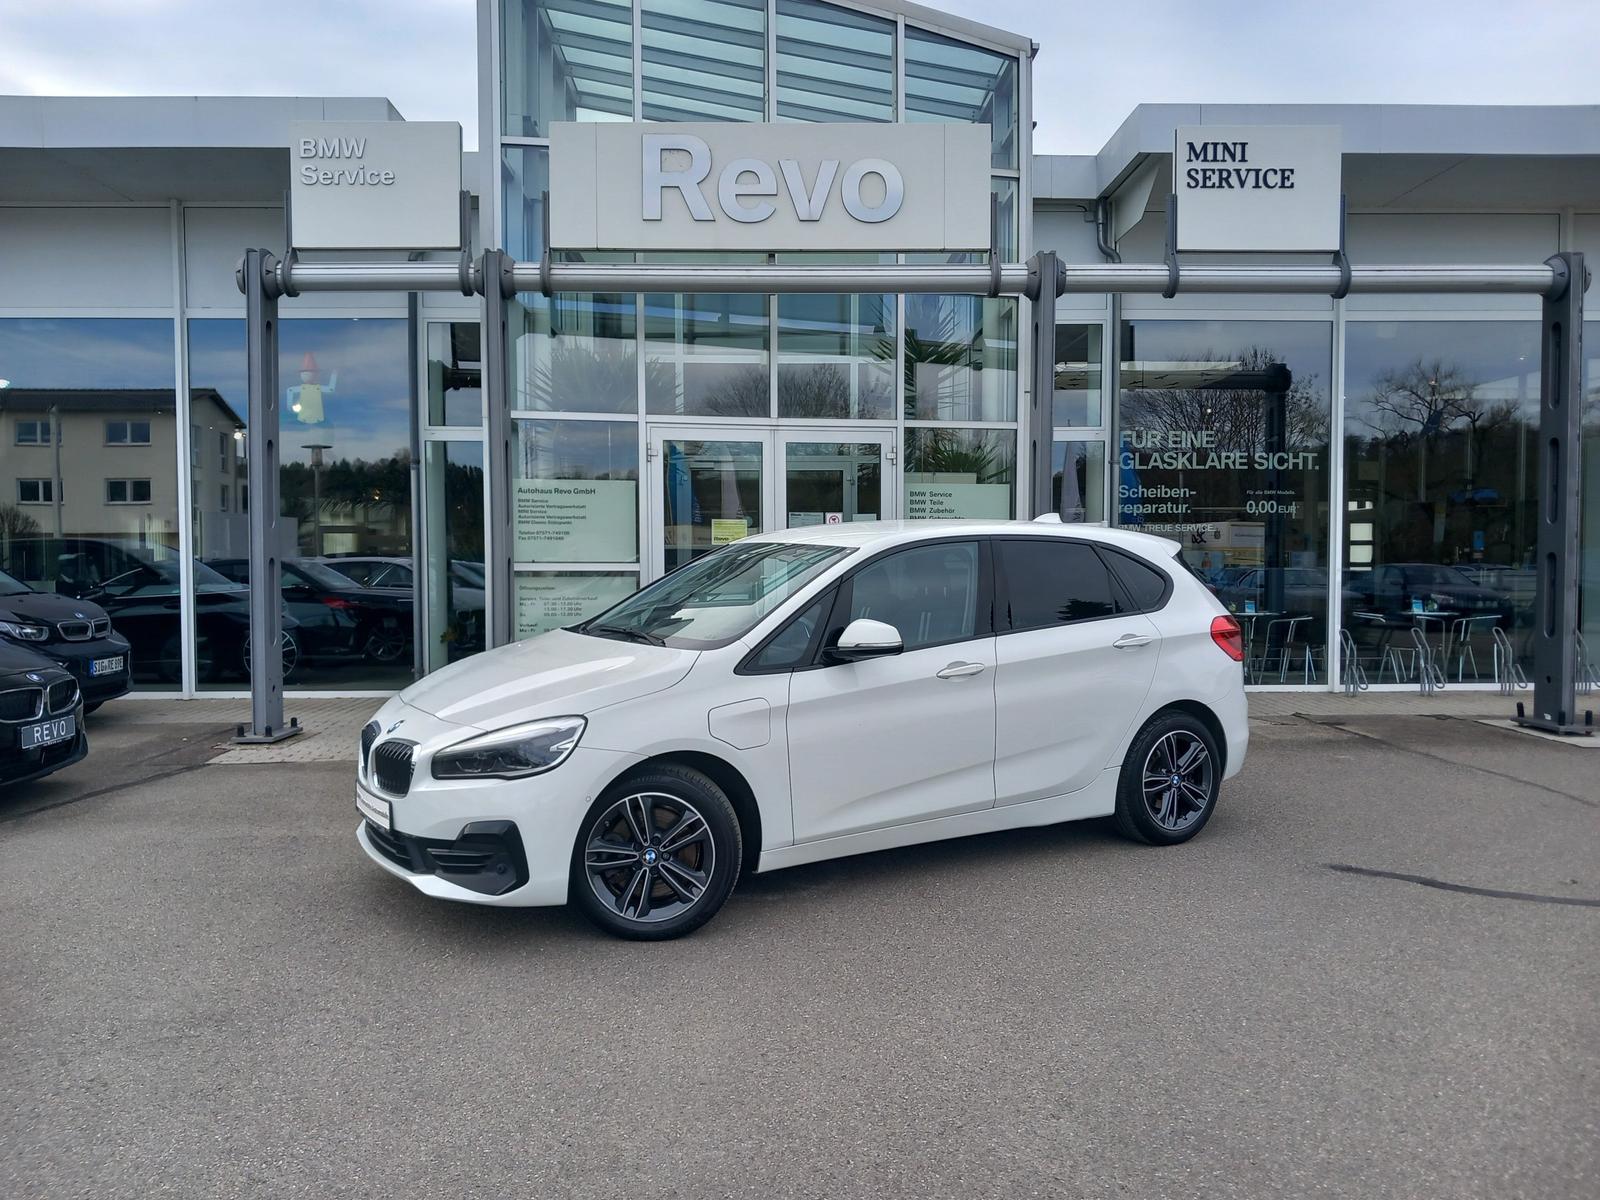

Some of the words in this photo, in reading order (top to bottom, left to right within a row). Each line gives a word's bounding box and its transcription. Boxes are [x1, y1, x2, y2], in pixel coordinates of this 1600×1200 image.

[299, 137, 367, 159] BMW
[1186, 142, 1249, 163] MINI
[300, 164, 396, 186] Service
[641, 133, 905, 224] Revo
[1186, 168, 1295, 190] SERVICE
[1119, 427, 1161, 449] FÜR
[1168, 431, 1215, 449] EINE
[1119, 452, 1249, 471] GLASKLARE
[1254, 452, 1320, 471] SICHT.
[518, 487, 553, 495] Autohaus
[554, 487, 572, 495] Revo
[573, 487, 596, 495] GmbH
[1119, 484, 1197, 499] Scheiben-
[1118, 502, 1191, 516] reparatur.
[1246, 500, 1277, 516] 0,00
[1144, 524, 1173, 532] TREUE
[33, 720, 66, 743] REVO
